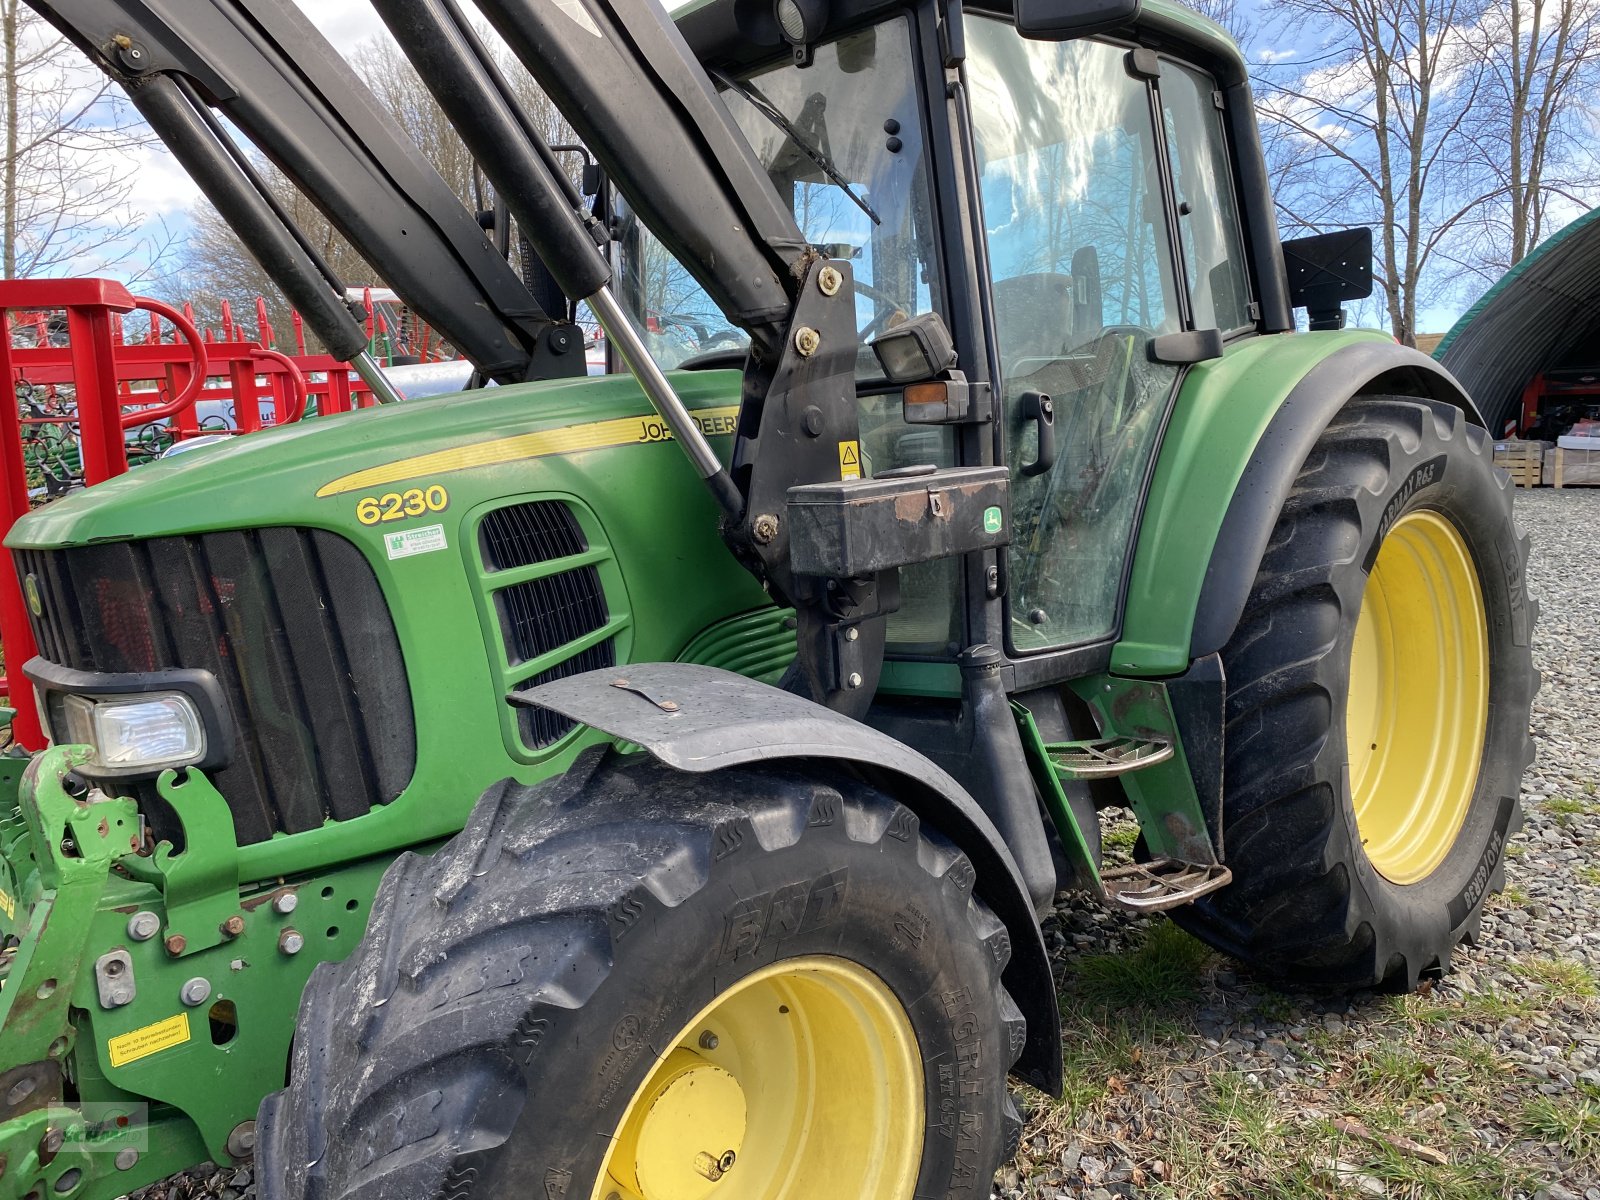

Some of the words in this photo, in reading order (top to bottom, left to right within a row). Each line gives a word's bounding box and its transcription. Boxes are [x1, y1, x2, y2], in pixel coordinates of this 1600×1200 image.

[639, 421, 670, 440] JOH
[690, 415, 738, 433] DEER
[356, 483, 449, 526] 6230
[405, 528, 441, 541] Streicher
[1463, 830, 1502, 910] 540/65R38
[116, 1041, 131, 1050] Nach
[140, 1023, 182, 1041] Betriebsstunden
[119, 1042, 148, 1056] Schrauben
[940, 986, 984, 1097] AGRI
[946, 1110, 984, 1200] MA
